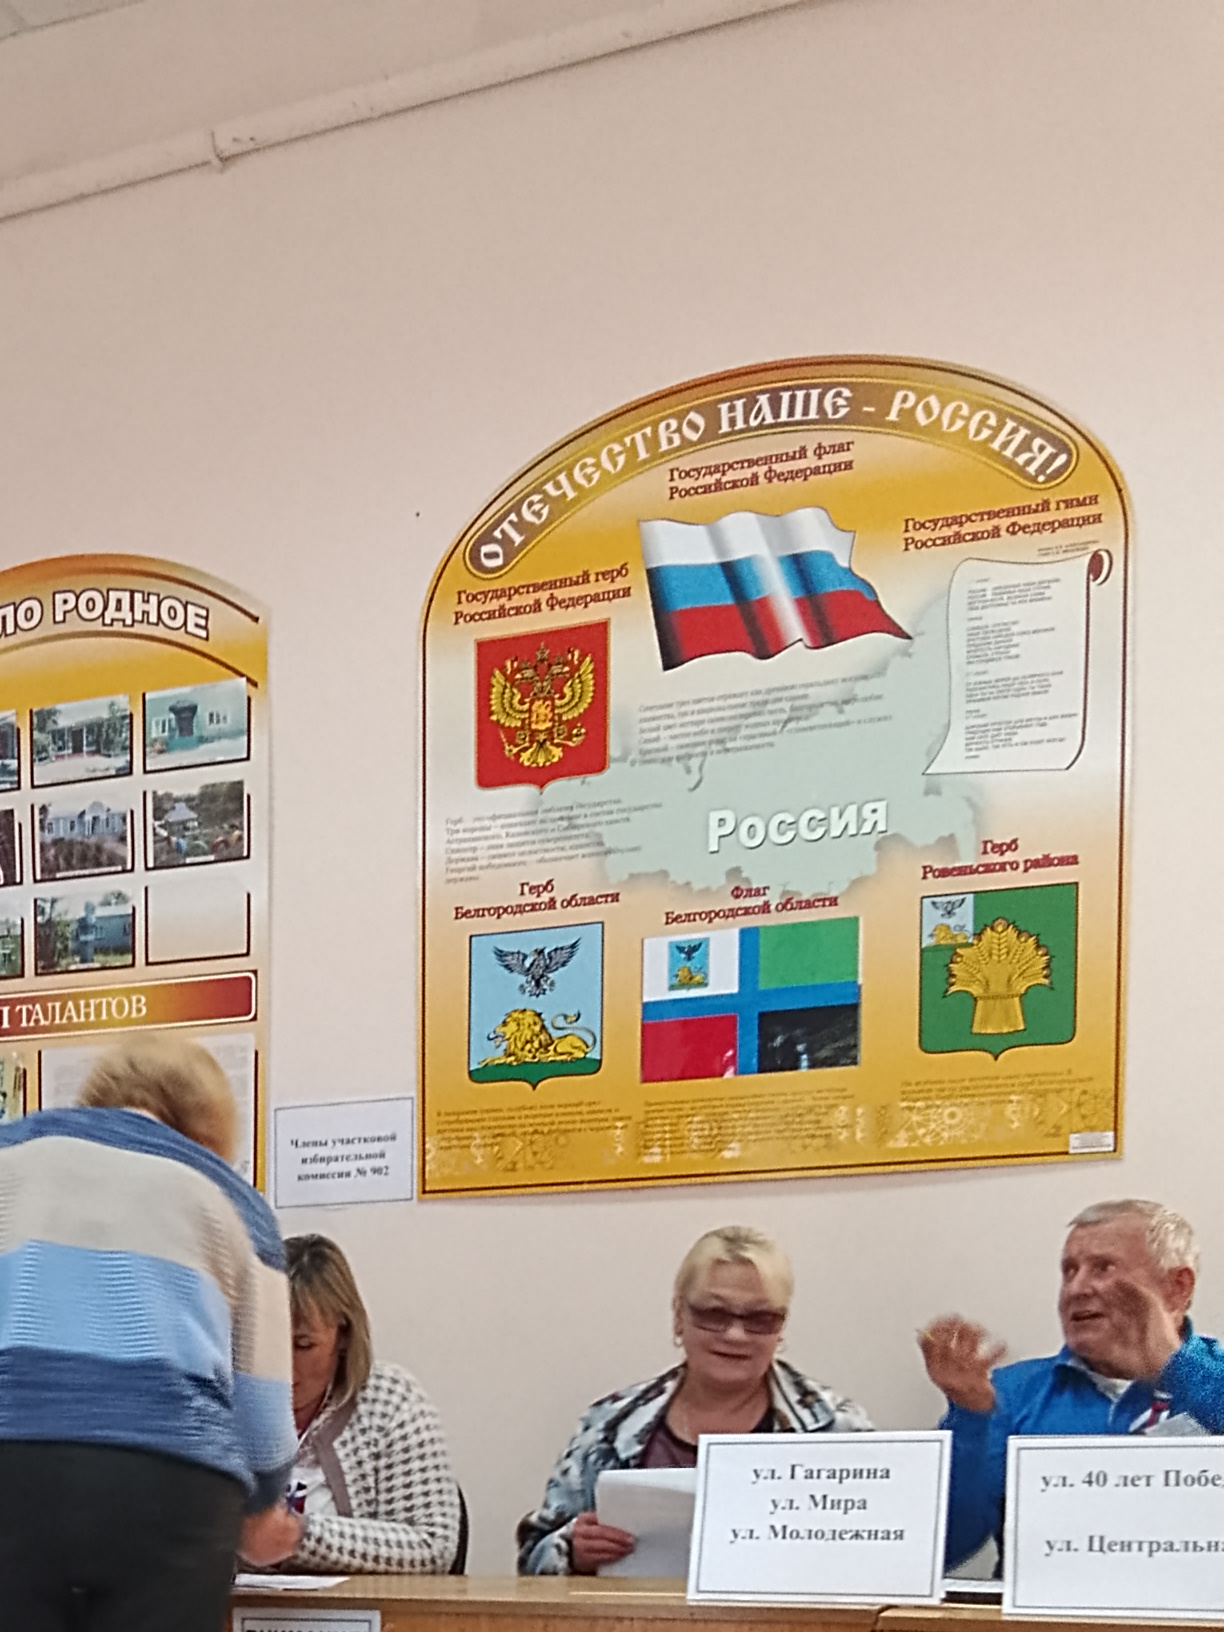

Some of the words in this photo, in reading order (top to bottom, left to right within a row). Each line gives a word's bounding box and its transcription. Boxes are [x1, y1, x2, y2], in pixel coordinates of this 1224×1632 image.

[669, 445, 807, 482] Государственный
[813, 441, 855, 460] флаг
[480, 411, 706, 568] ОТЕЧЕСТВО
[718, 386, 853, 434] НАШЕ
[886, 390, 1068, 482] РОССИЯ!
[669, 472, 760, 500] Российской
[764, 459, 855, 485] Федерации
[904, 499, 1050, 532] Государственный
[1055, 494, 1099, 511] гимн
[904, 525, 1001, 551] Российской
[1006, 512, 1103, 537] Федерации
[457, 570, 591, 605] Государственный
[594, 562, 629, 584] герб
[52, 588, 210, 641] РОДНОЕ
[454, 599, 542, 625] Российской
[546, 586, 632, 611] Федерации
[981, 838, 1019, 856] Герб
[921, 858, 1019, 881] Ровеньского
[1023, 852, 1079, 874] района
[519, 879, 554, 896] Герб
[730, 884, 770, 901] Флаг
[454, 897, 557, 921] Белгородской
[560, 889, 620, 910] области
[664, 901, 771, 926] Белгородской
[775, 893, 839, 914] области
[15, 995, 148, 1029] ТАЛАНТОВ
[290, 1138, 328, 1149] Члены
[331, 1132, 397, 1149] участковой
[301, 1150, 386, 1166] избирательной
[297, 1172, 352, 1181] комиссии
[751, 1468, 782, 1484] ул.
[789, 1464, 891, 1484] Гагарина
[1041, 1475, 1075, 1492] ул.
[1082, 1470, 1108, 1487] 40
[1114, 1474, 1154, 1488] лет
[1163, 1469, 1224, 1488] Побе
[769, 1498, 800, 1514] ул.
[808, 1494, 867, 1514] Мира
[729, 1528, 760, 1544] ул.
[767, 1524, 905, 1542] Молодежная
[1045, 1540, 1079, 1557] ул.
